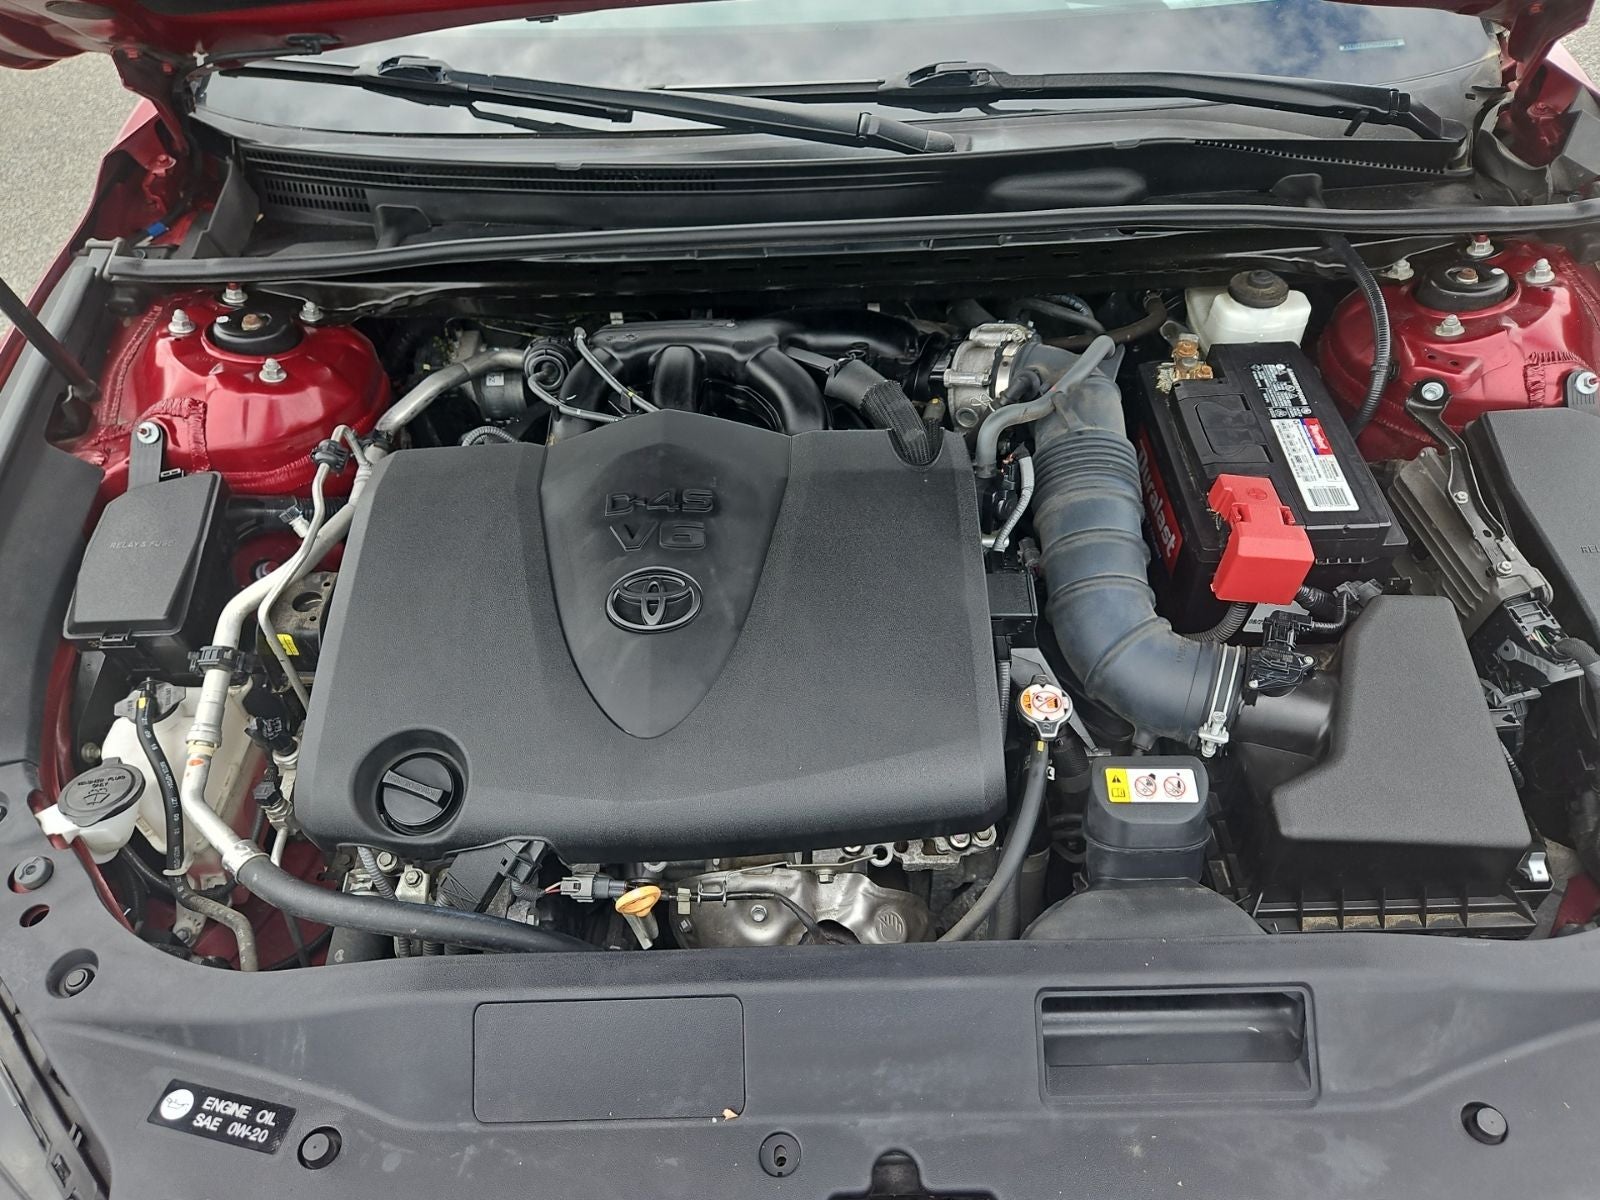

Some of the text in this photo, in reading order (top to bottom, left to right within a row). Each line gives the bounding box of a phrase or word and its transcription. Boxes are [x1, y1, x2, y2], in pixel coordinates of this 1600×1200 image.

[604, 488, 713, 517] D-4S
[609, 519, 706, 552] V6
[202, 1097, 277, 1126] ENGINE OIL
[192, 1113, 269, 1143] SAE 0W-20
